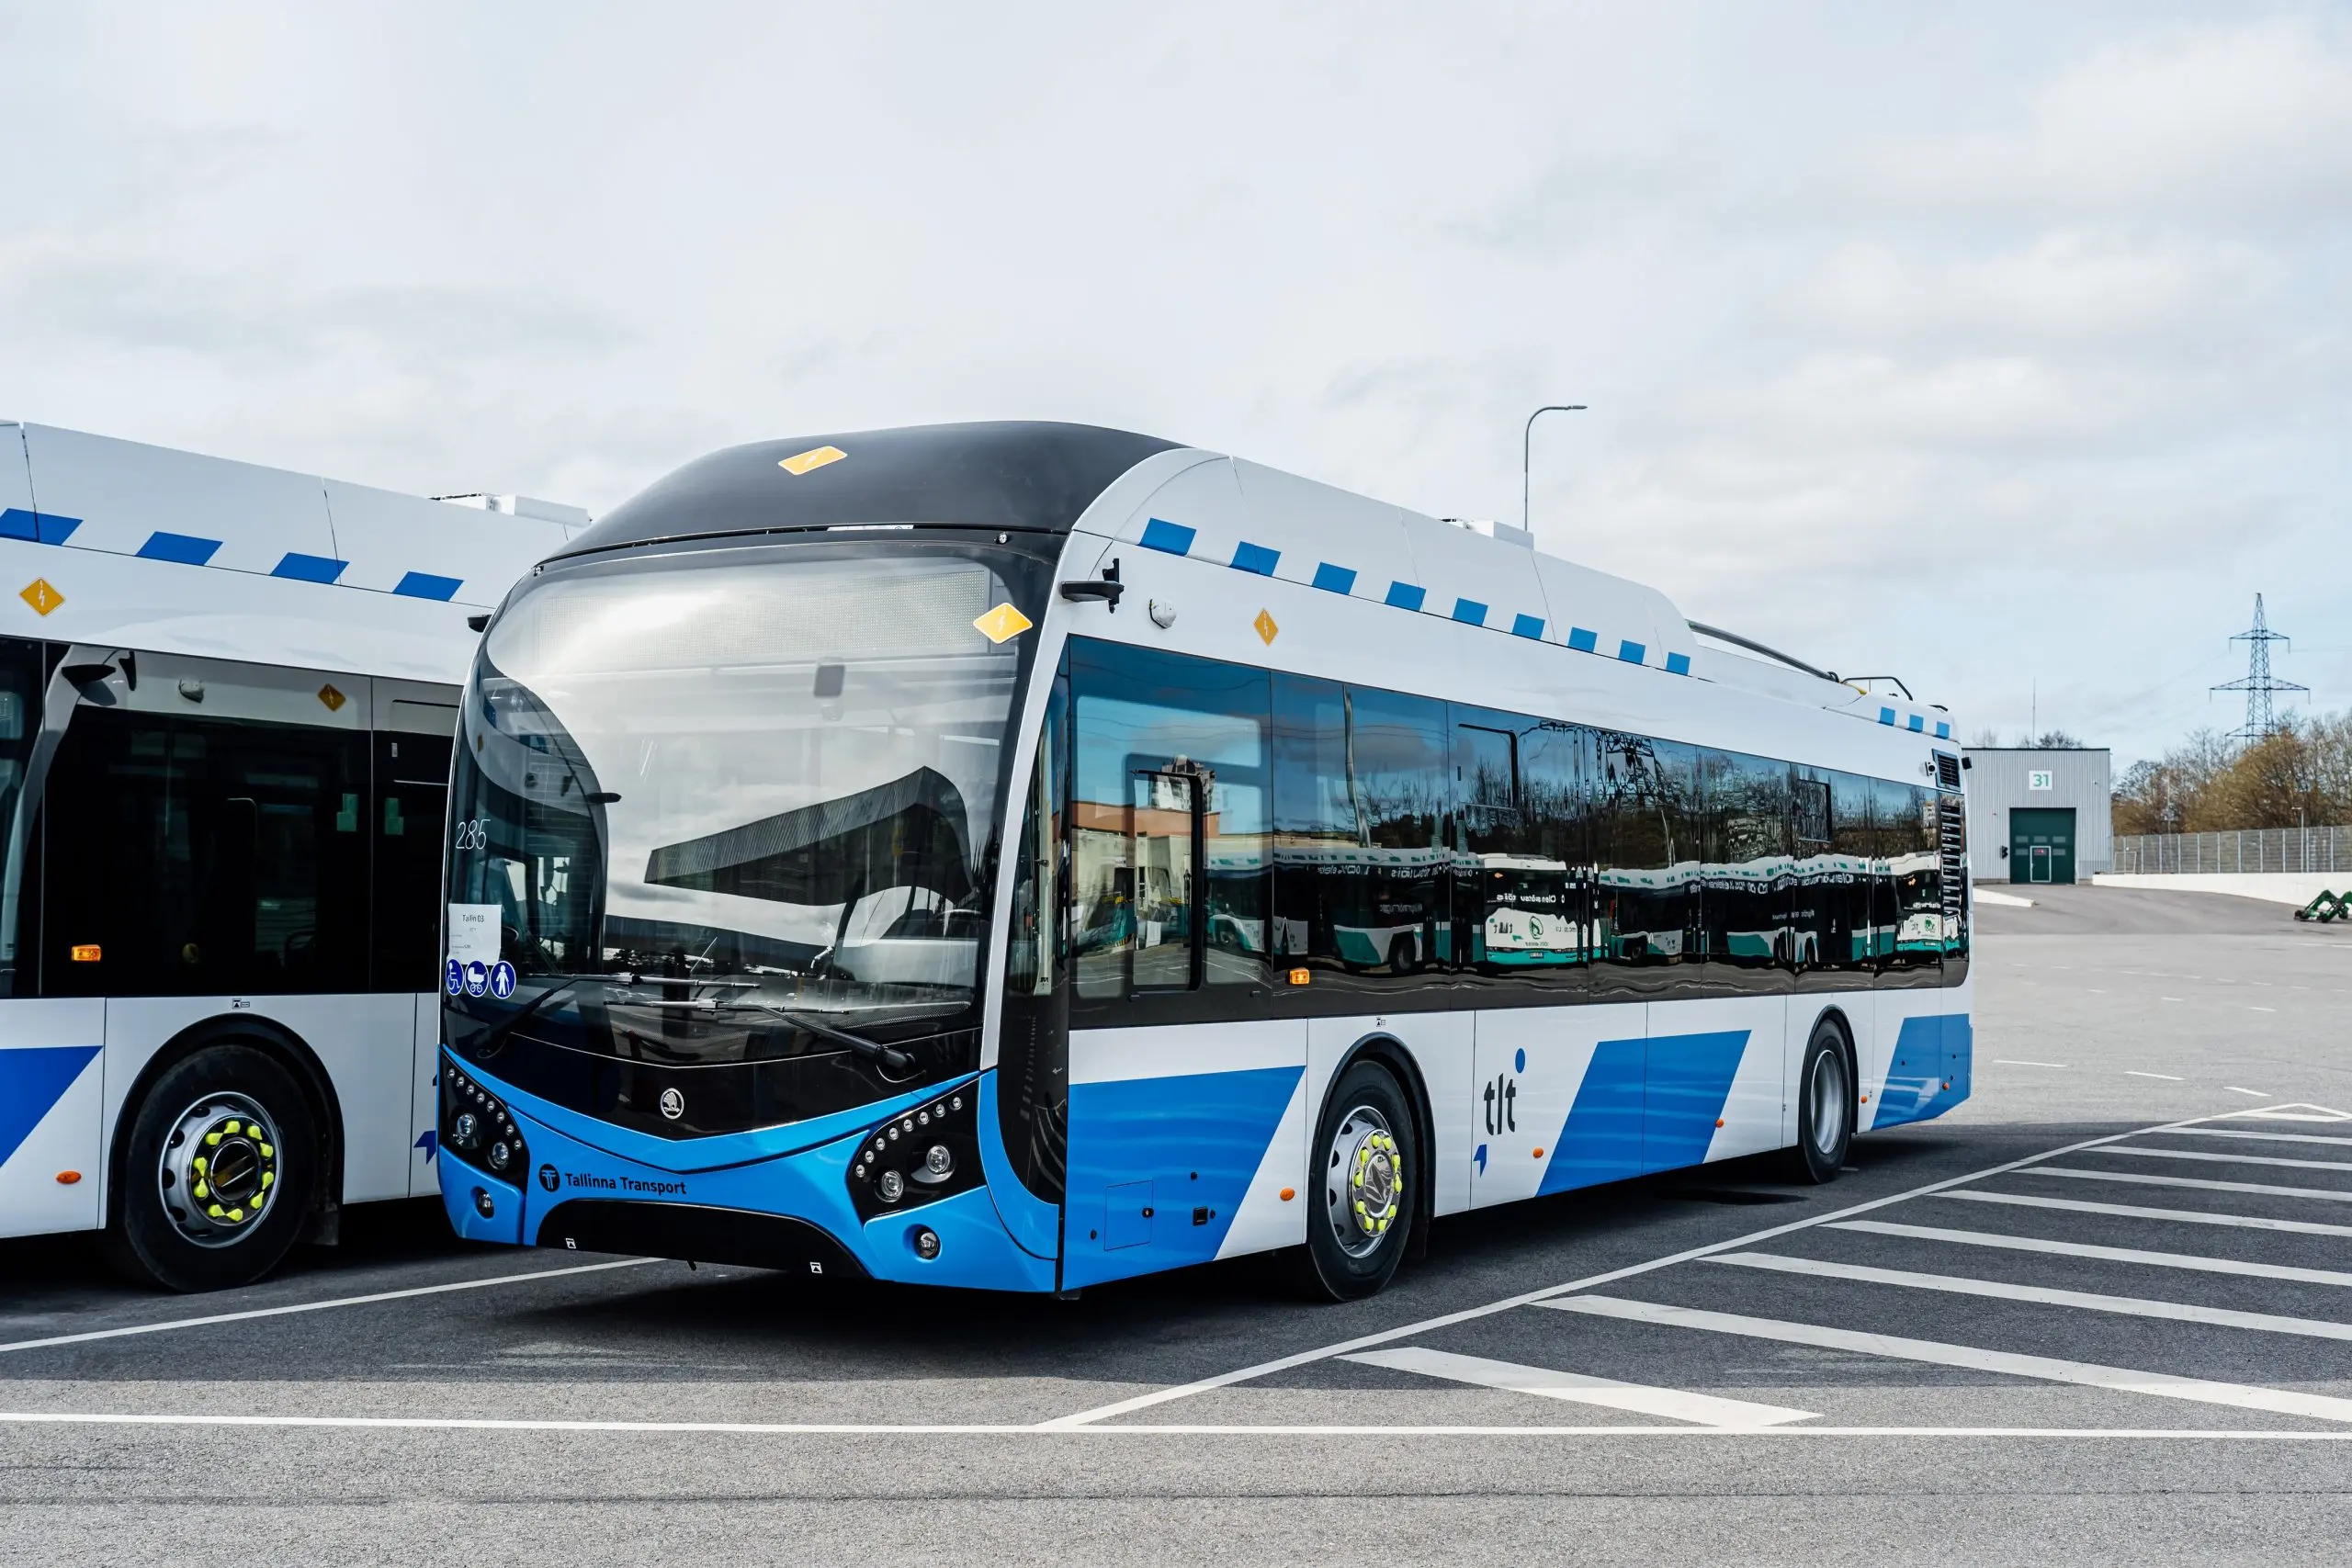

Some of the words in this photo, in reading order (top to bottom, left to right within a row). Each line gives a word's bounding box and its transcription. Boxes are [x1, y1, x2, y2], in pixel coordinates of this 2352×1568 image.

[2032, 773, 2049, 787] 31
[455, 818, 491, 851] 285
[1483, 1073, 1517, 1135] tlt
[565, 1173, 616, 1190] Tallinna
[620, 1176, 687, 1196] Transport
